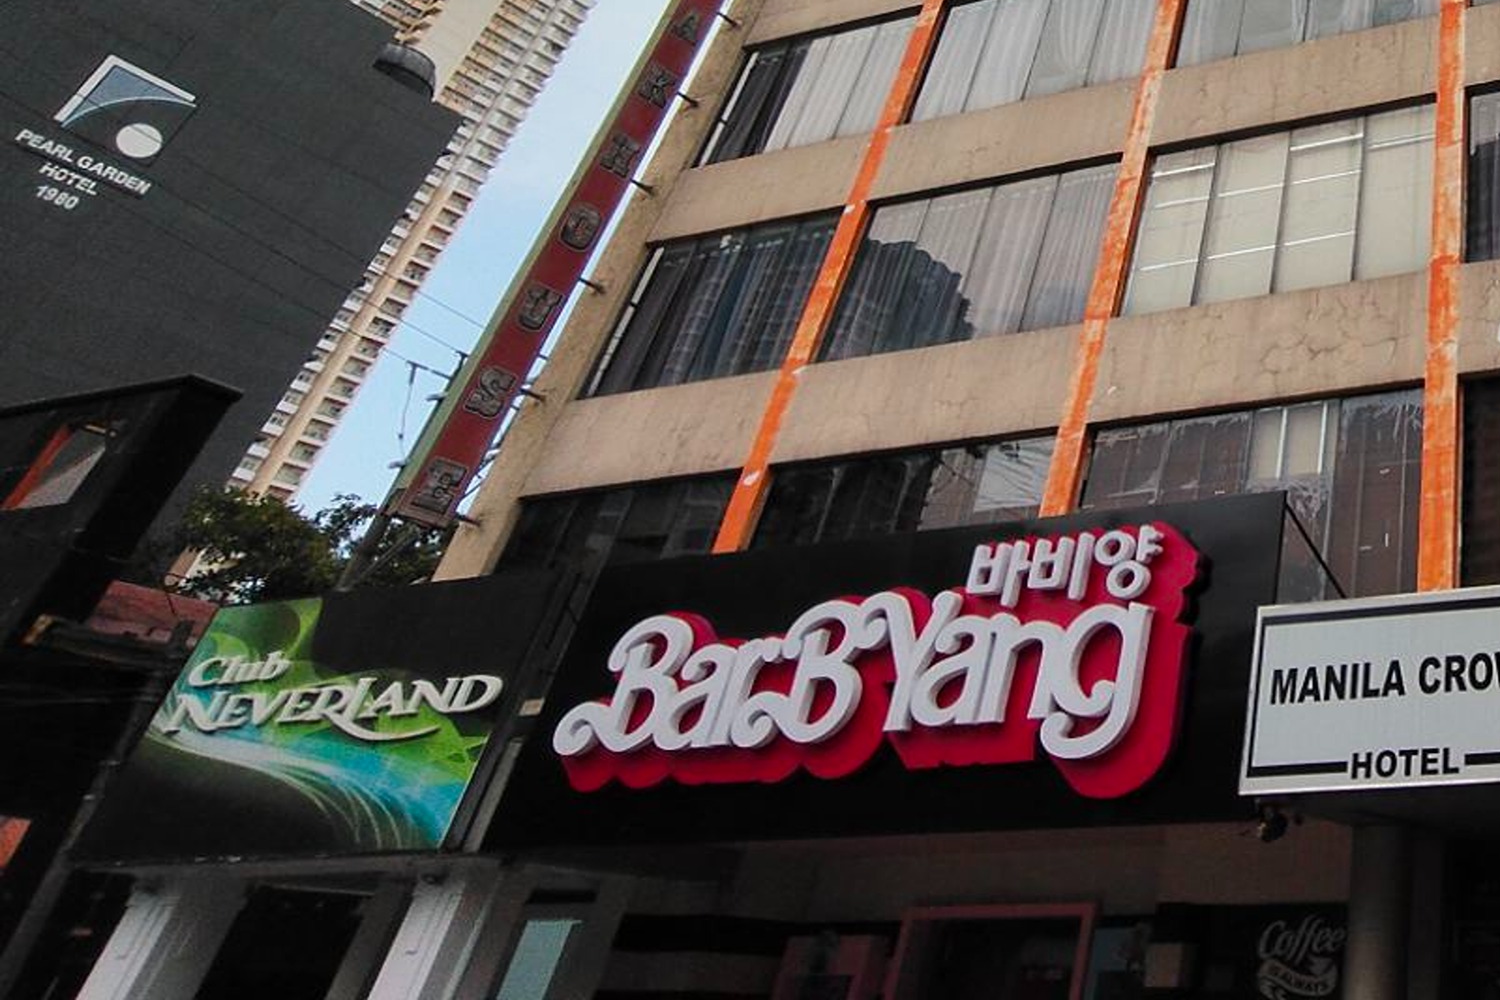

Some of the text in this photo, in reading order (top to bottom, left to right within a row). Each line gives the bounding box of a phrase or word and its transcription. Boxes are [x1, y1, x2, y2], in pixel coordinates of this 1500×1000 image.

[15, 128, 151, 195] PEARL GARDEN
[39, 163, 98, 196] HOTEL
[36, 185, 79, 209] 1980
[966, 524, 1165, 607] 바비양
[188, 650, 292, 688] Club
[1270, 659, 1405, 705] MANILA
[1351, 748, 1459, 779] HOTEL
[1258, 912, 1346, 966] Coffee
